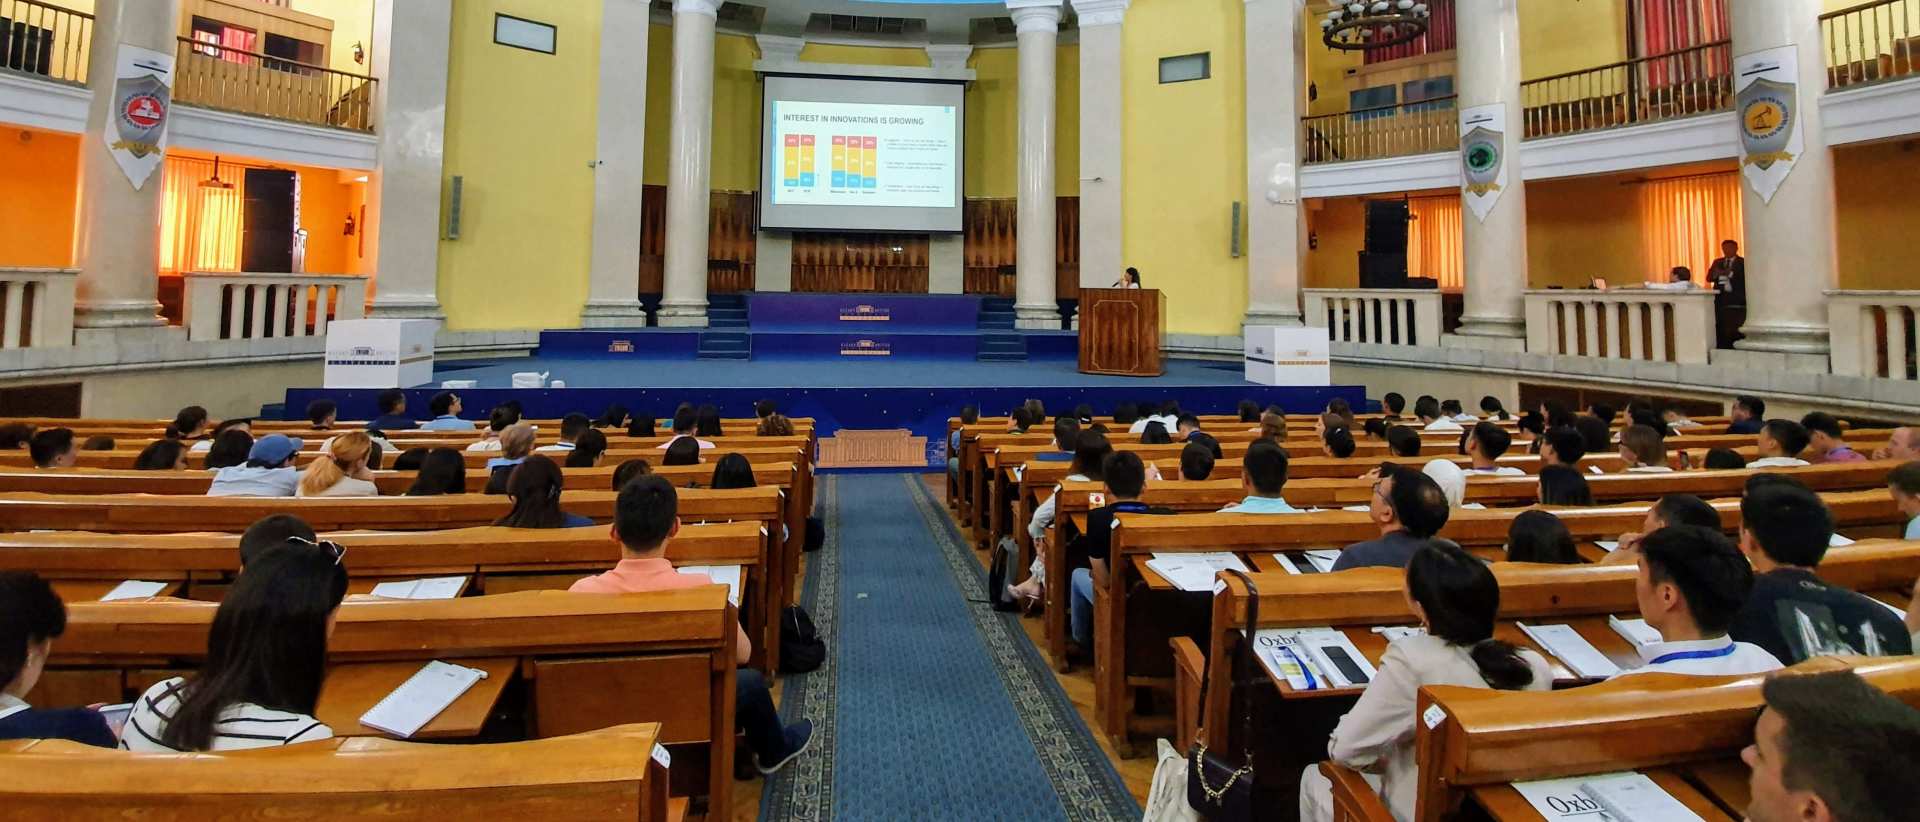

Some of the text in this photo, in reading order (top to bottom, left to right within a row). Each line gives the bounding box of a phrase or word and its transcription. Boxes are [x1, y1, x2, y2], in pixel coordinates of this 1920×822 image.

[783, 113, 924, 126] INTEREST IN INNOVATIONS IS GROWING
[1546, 793, 1604, 813] Oxb
